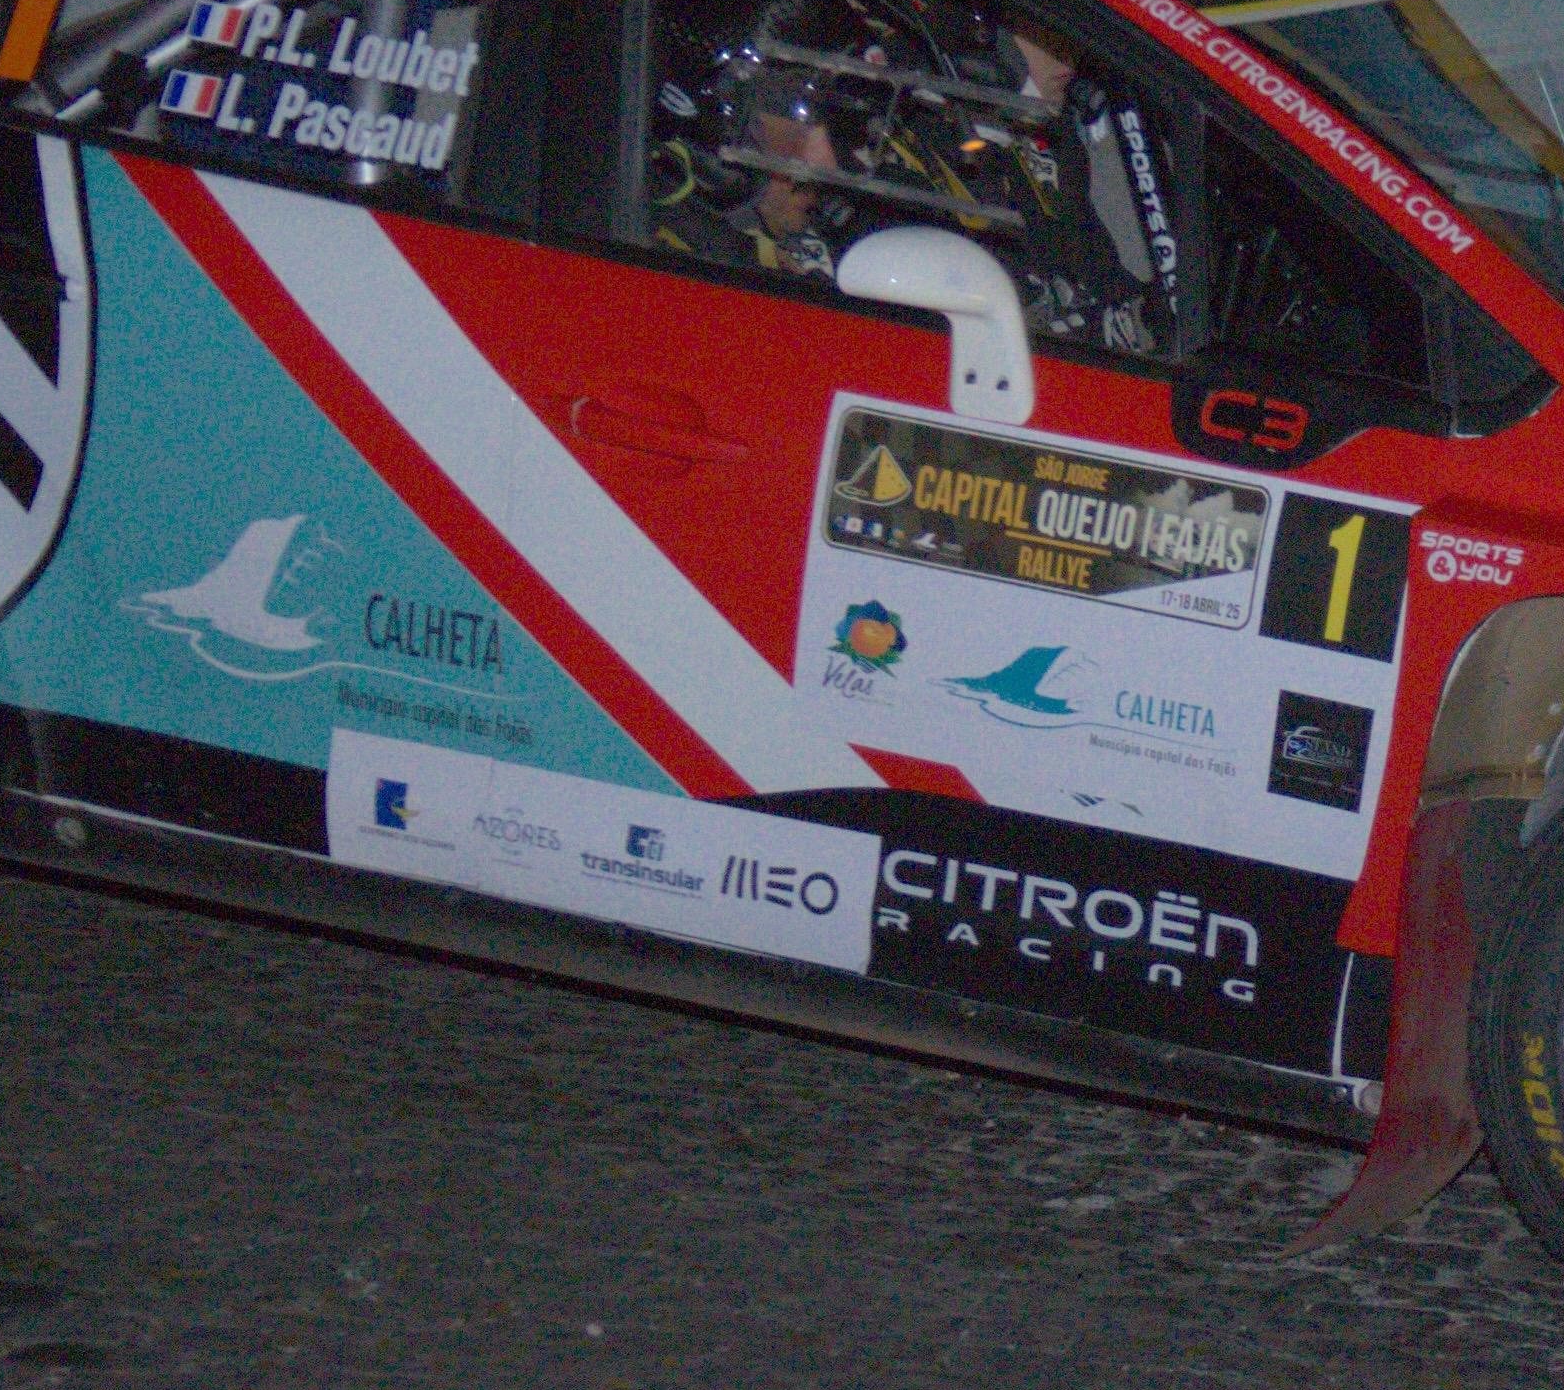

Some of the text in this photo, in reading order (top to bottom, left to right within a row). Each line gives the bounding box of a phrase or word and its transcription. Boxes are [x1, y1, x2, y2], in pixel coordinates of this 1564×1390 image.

[239, 2, 480, 97] P.L. Loubet
[215, 72, 460, 172] L. Pascaud
[1119, 109, 1168, 234] SPORTS
[1199, 386, 1310, 452] C3
[1033, 453, 1111, 493] SÃO JORGE
[912, 464, 1251, 573] CAPITAL QUEIJO FAJÃS
[1418, 529, 1526, 567] SPORTS
[1015, 545, 1094, 591] RALLYE
[1322, 511, 1369, 646] 1
[364, 592, 504, 675] CALHETA
[1114, 689, 1215, 739] CALHETA
[1143, 745, 1184, 765] capital
[1183, 754, 1205, 771] das
[471, 813, 562, 852] AZORES
[579, 850, 705, 892] transinsular
[720, 855, 840, 916] MEO
[880, 843, 1262, 968] CITROËN
